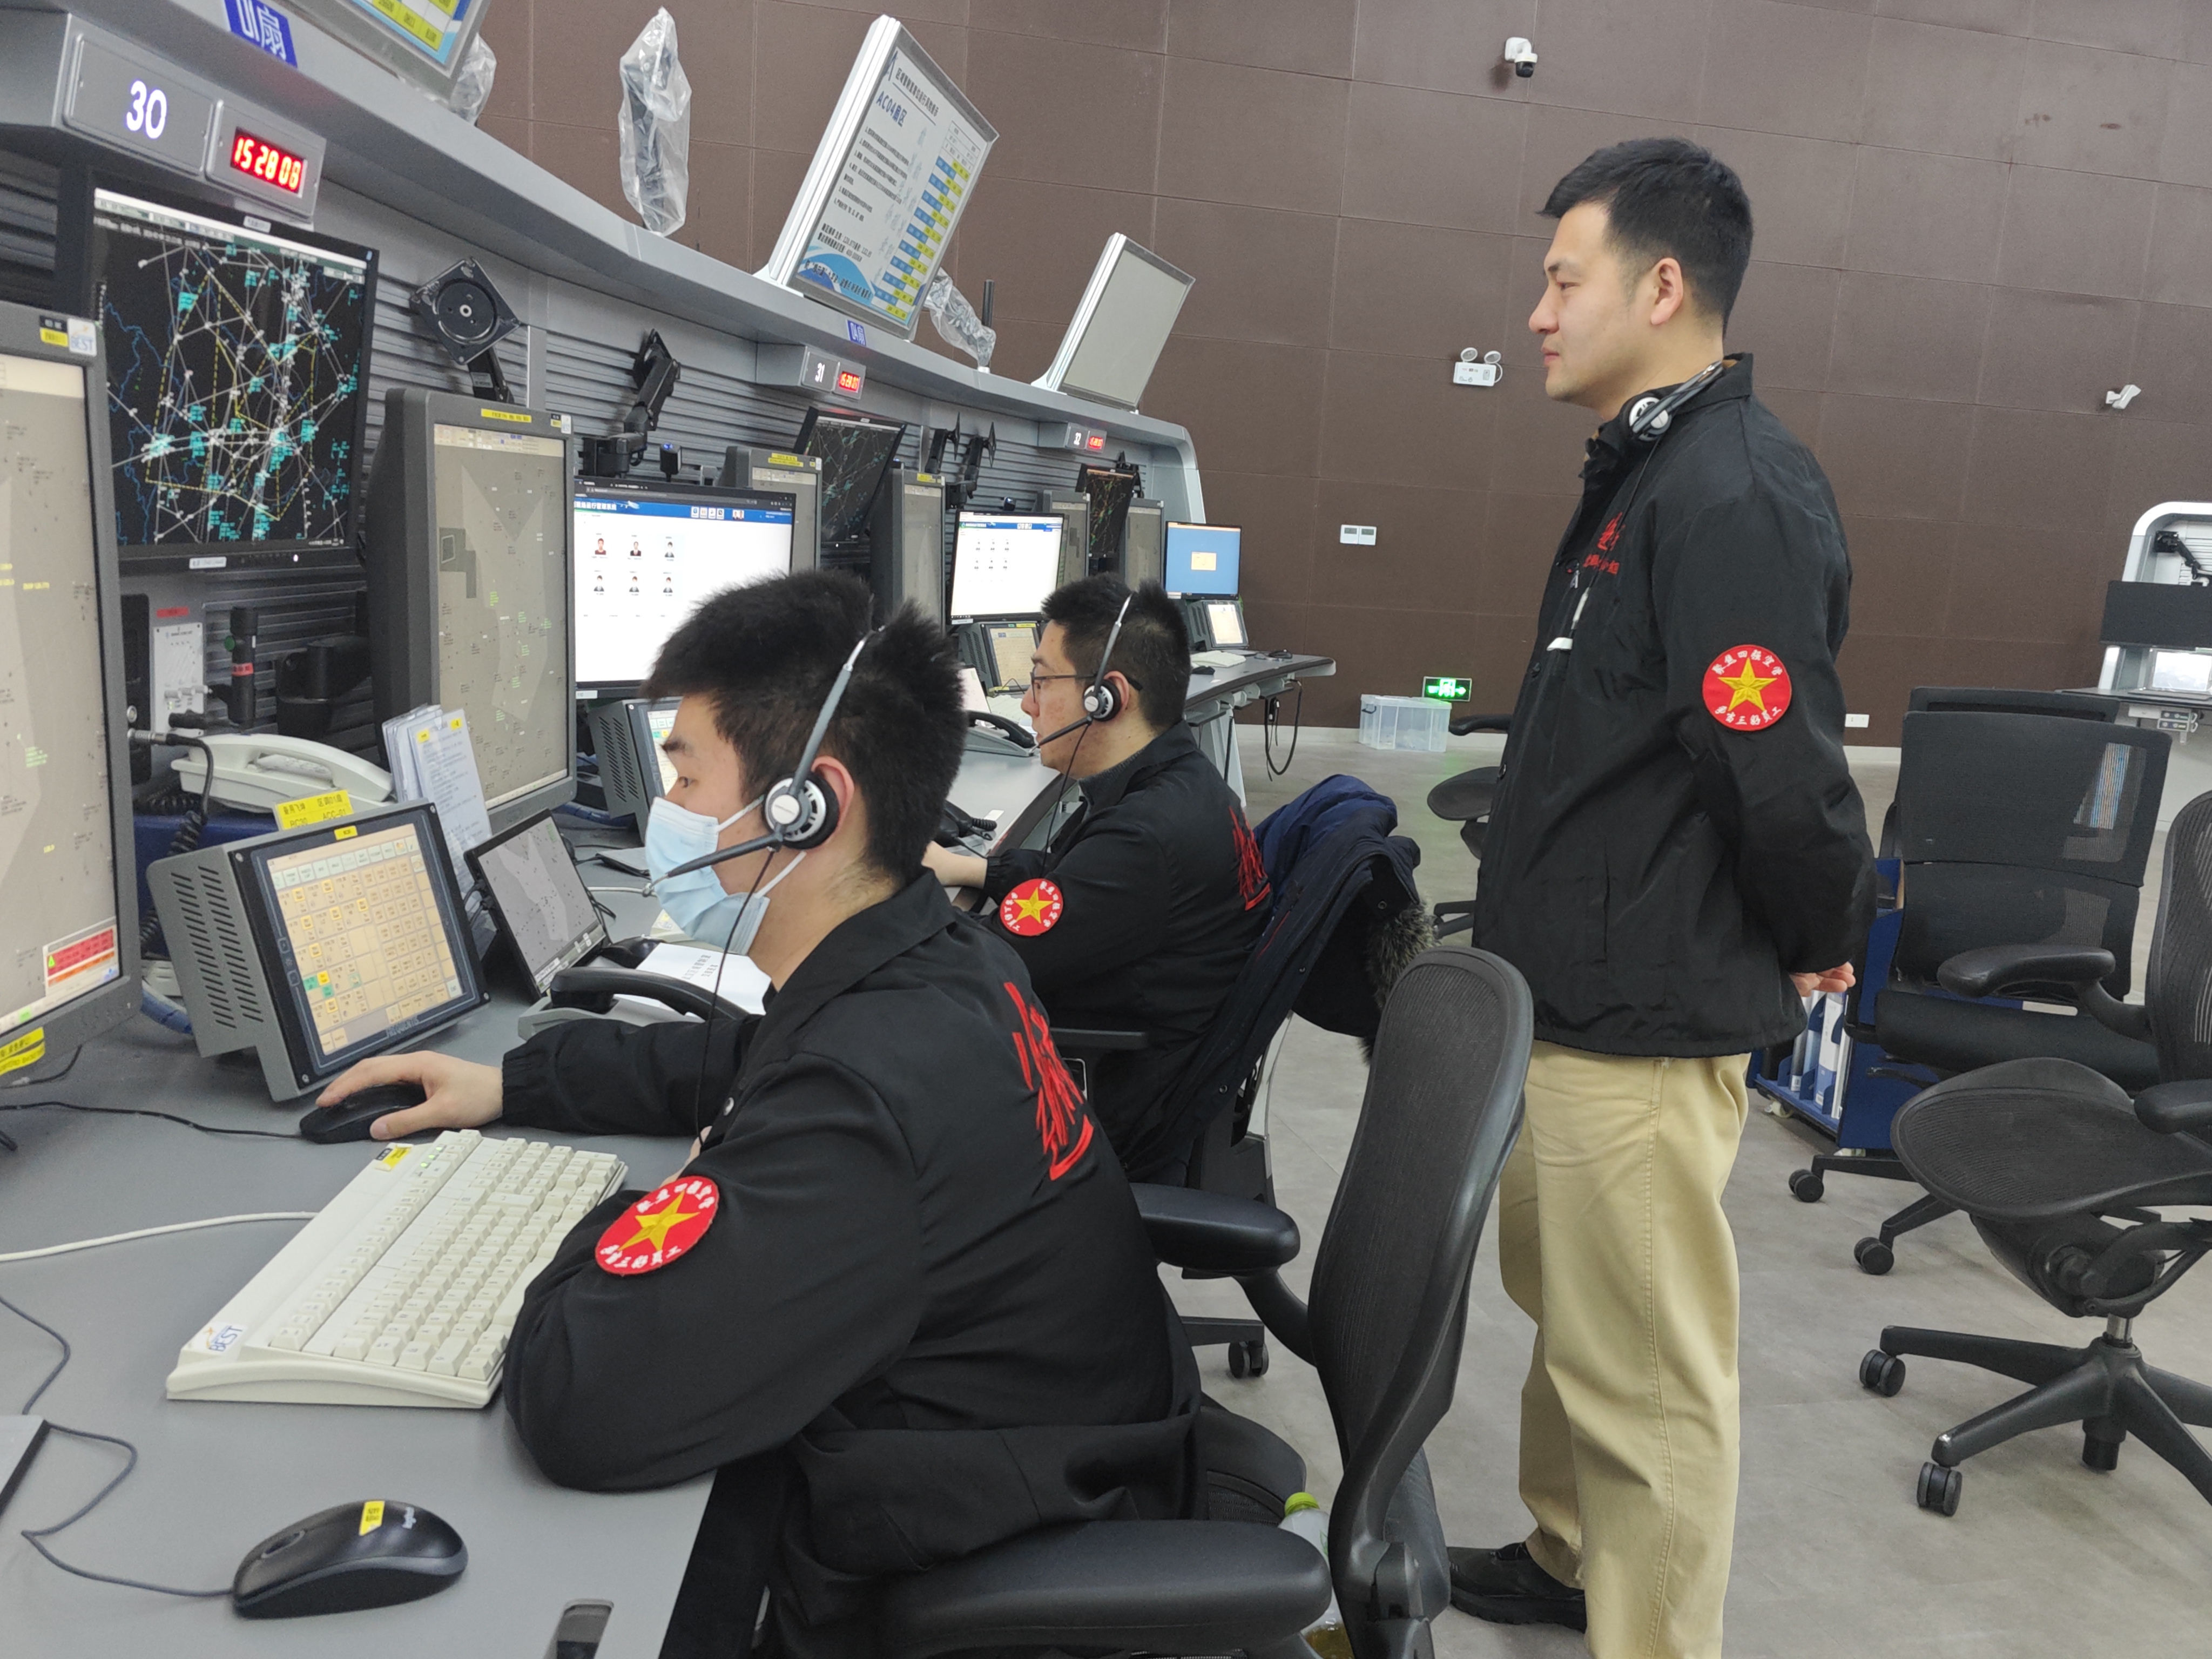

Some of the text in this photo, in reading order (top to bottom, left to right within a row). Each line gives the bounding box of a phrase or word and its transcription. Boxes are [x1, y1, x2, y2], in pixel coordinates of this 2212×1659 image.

[126, 79, 167, 139] 30
[814, 362, 825, 383] 31
[208, 1325, 243, 1352] BEST
